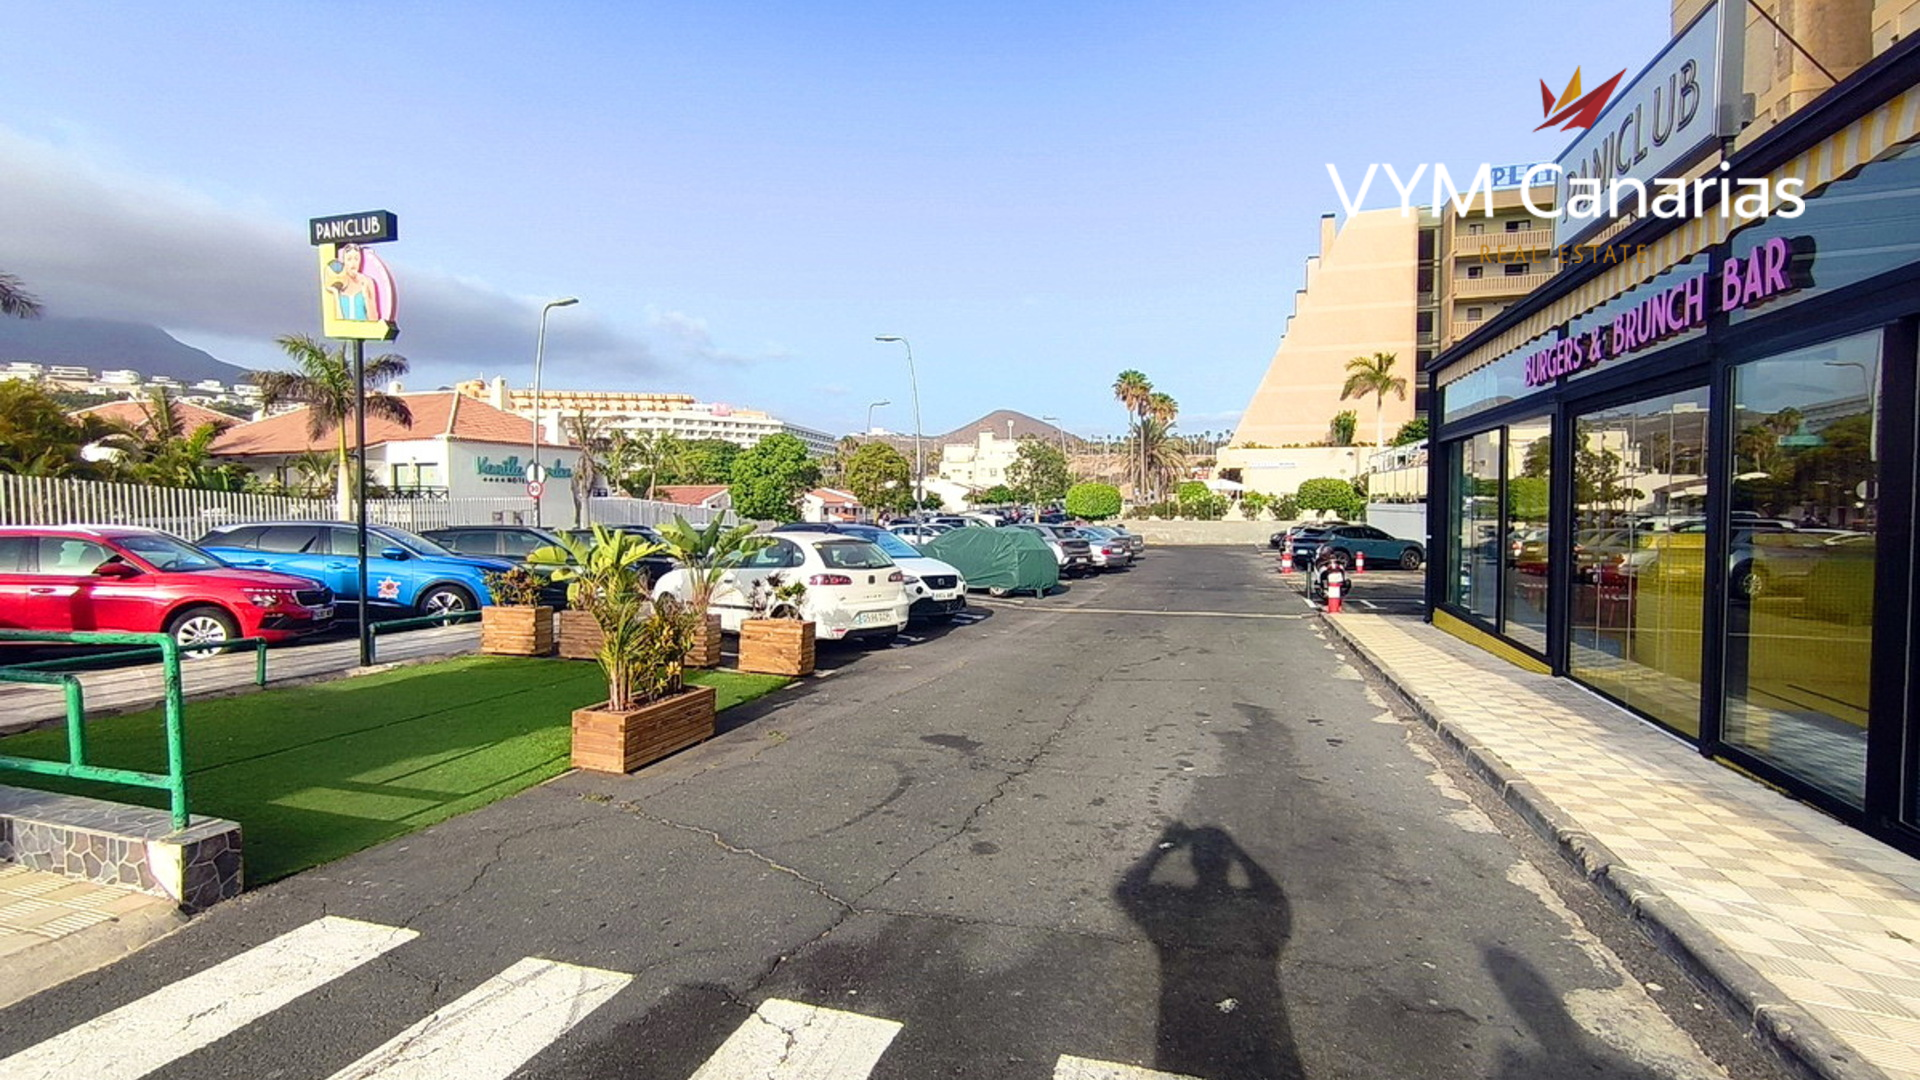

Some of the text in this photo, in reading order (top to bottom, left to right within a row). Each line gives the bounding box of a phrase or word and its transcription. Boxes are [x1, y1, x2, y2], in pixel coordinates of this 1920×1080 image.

[1563, 58, 1700, 224] PANICLUB
[315, 215, 381, 240] PANICLUB
[1524, 236, 1789, 388] BURGERS & BRUNCH BAR
[477, 456, 526, 476] Vanilla
